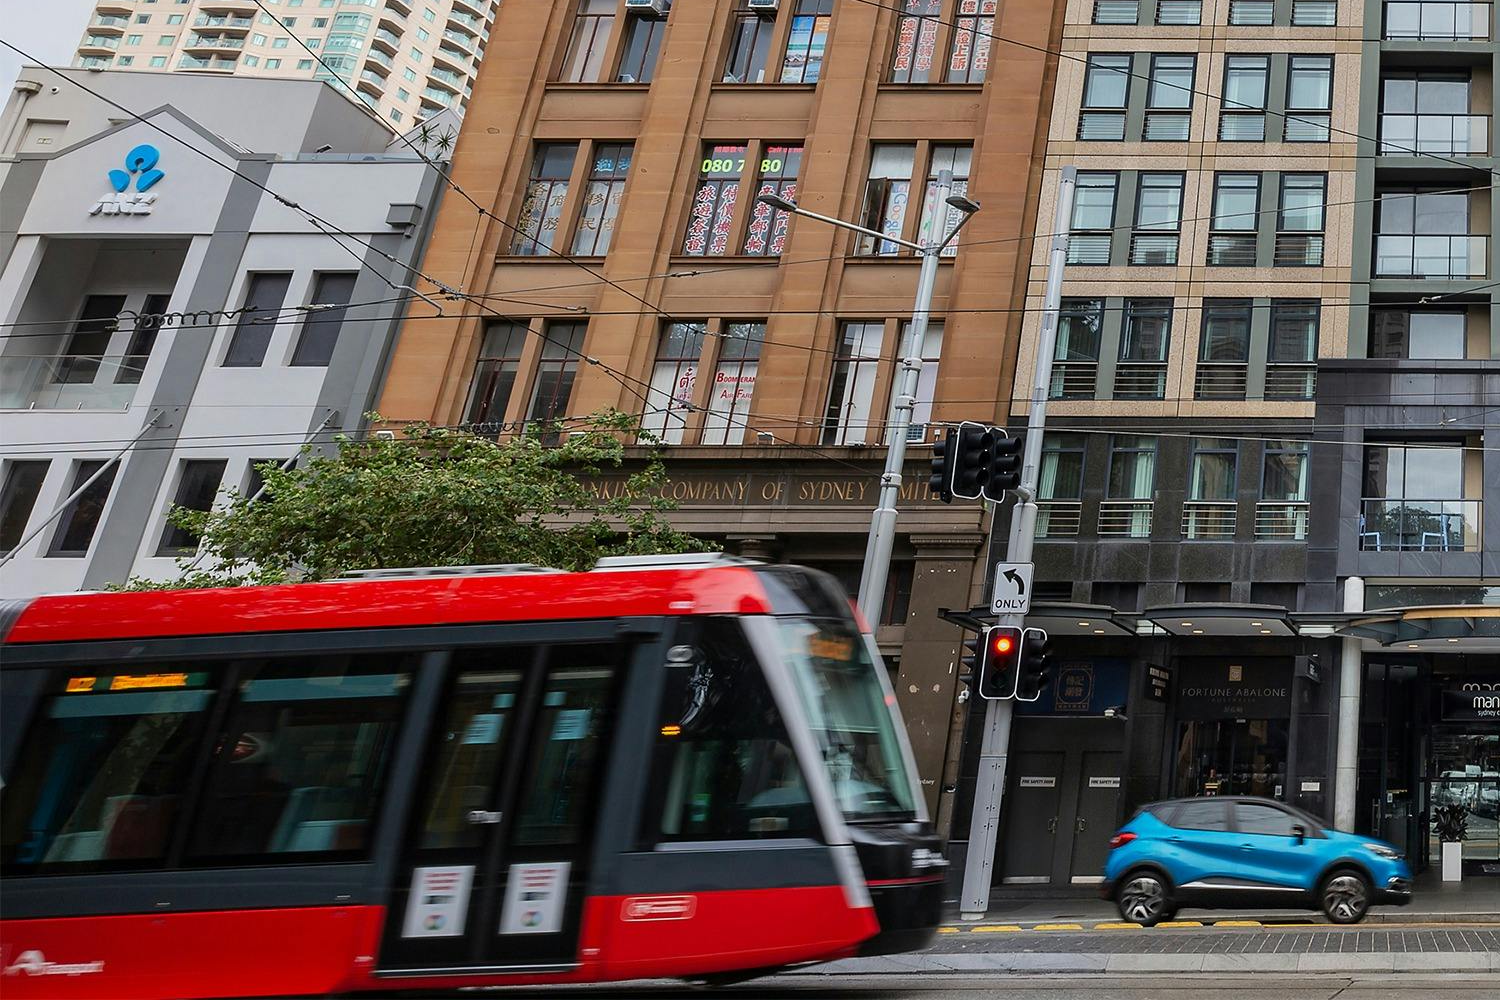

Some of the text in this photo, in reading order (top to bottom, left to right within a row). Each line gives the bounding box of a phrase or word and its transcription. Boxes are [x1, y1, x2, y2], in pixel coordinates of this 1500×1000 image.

[88, 193, 157, 215] ANZ
[660, 481, 749, 500] COMPANY
[762, 481, 786, 500] OF
[799, 481, 870, 500] SYDNEY
[995, 599, 1026, 609] ONLY
[1182, 688, 1286, 697] FORTUNE ABALONE
[1478, 709, 1496, 717] sydney
